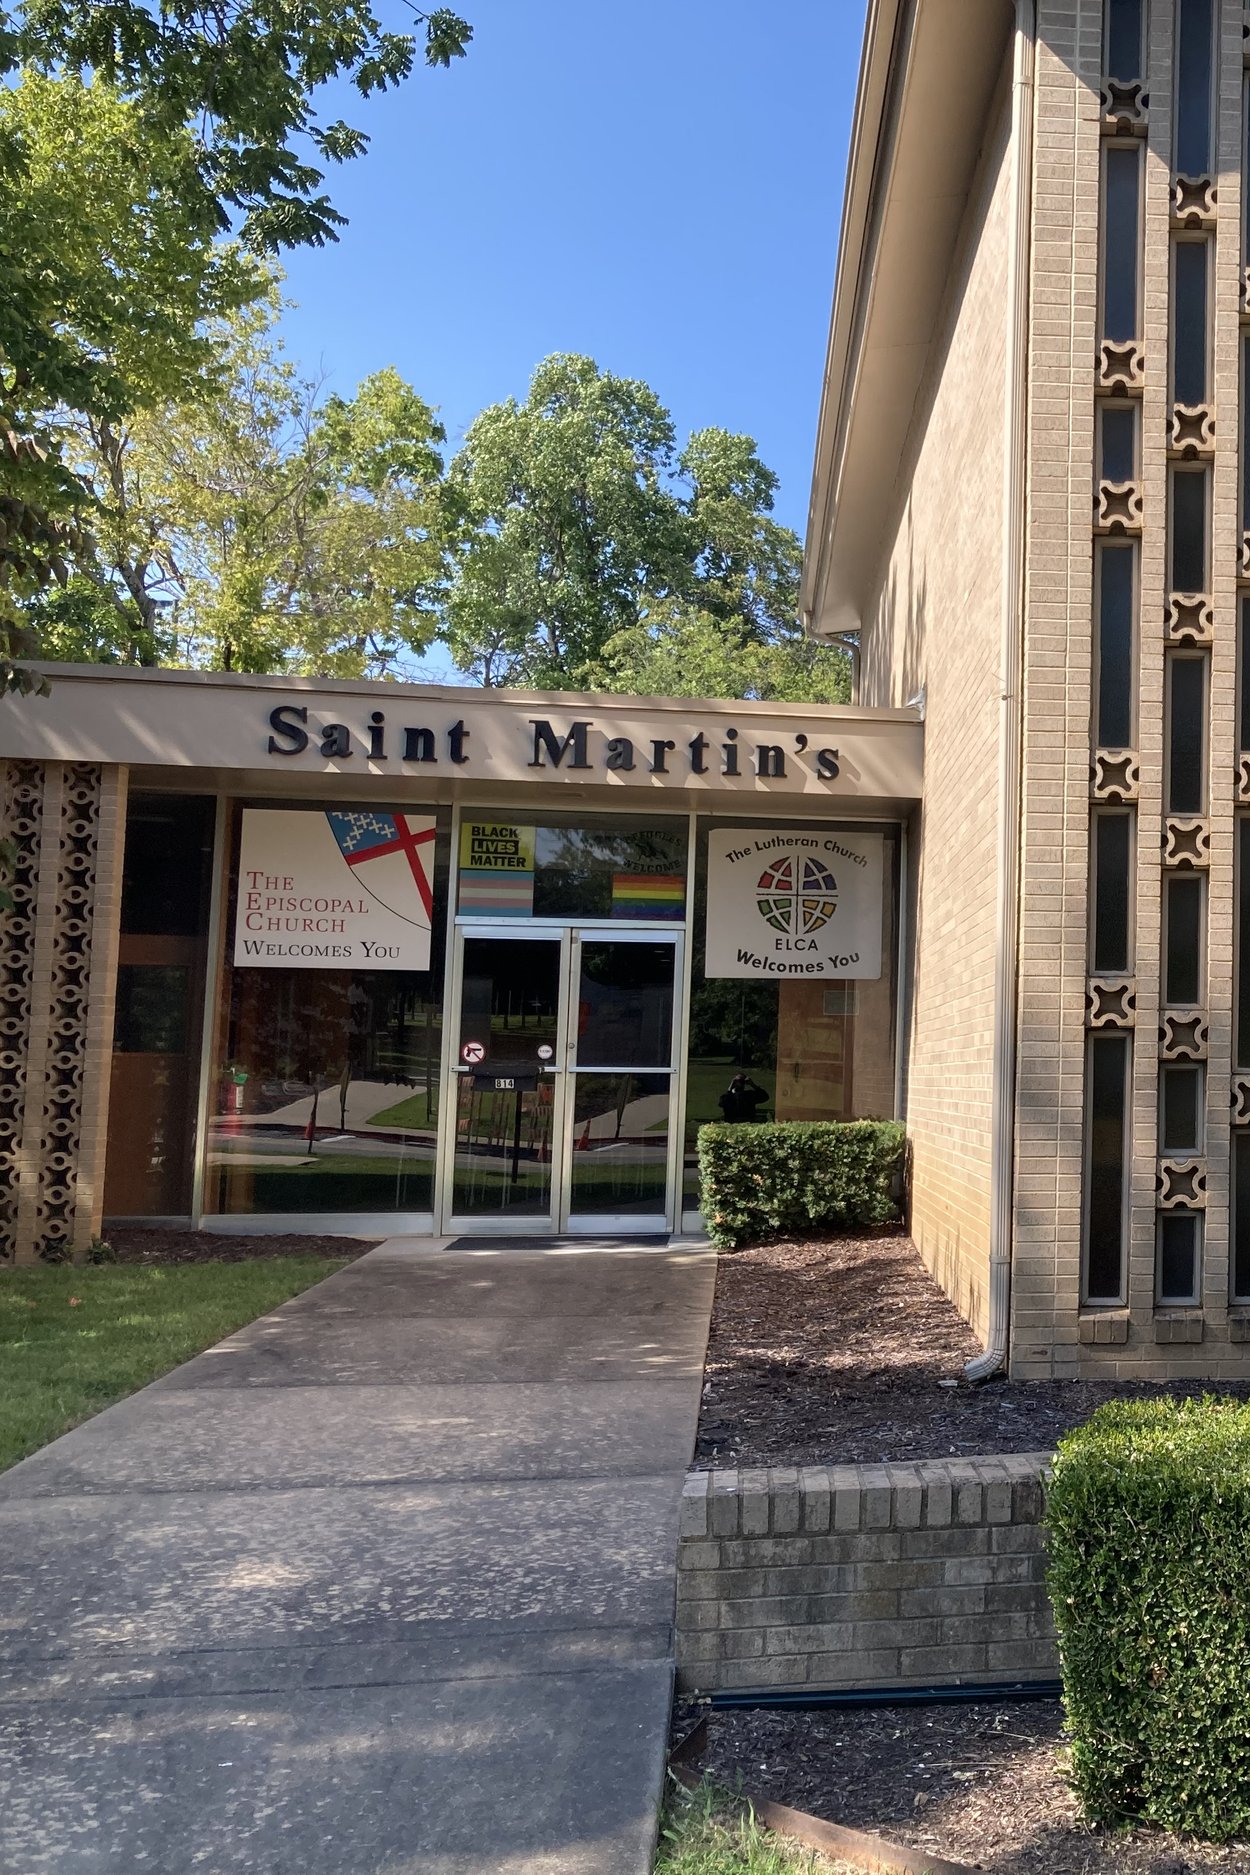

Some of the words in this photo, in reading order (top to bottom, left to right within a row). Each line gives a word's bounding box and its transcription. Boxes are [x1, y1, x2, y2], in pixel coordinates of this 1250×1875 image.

[268, 706, 471, 764] Saint
[528, 719, 840, 781] Martin's
[471, 825, 520, 838] BLACK
[474, 840, 515, 854] LIVES
[725, 847, 752, 864] The
[754, 836, 818, 852] Lutheran
[824, 840, 868, 868] Church
[470, 855, 527, 868] MATTER
[624, 858, 681, 873] WELCOME
[246, 871, 294, 891] THE
[245, 892, 369, 913] EPISCOPAL
[245, 912, 346, 933] CHURCH
[243, 939, 352, 957] WELCOMES
[360, 941, 400, 959] YOU
[775, 938, 818, 951] ELCA
[736, 949, 824, 973] Welcomes
[828, 952, 860, 969] You
[496, 1079, 513, 1088] 814
